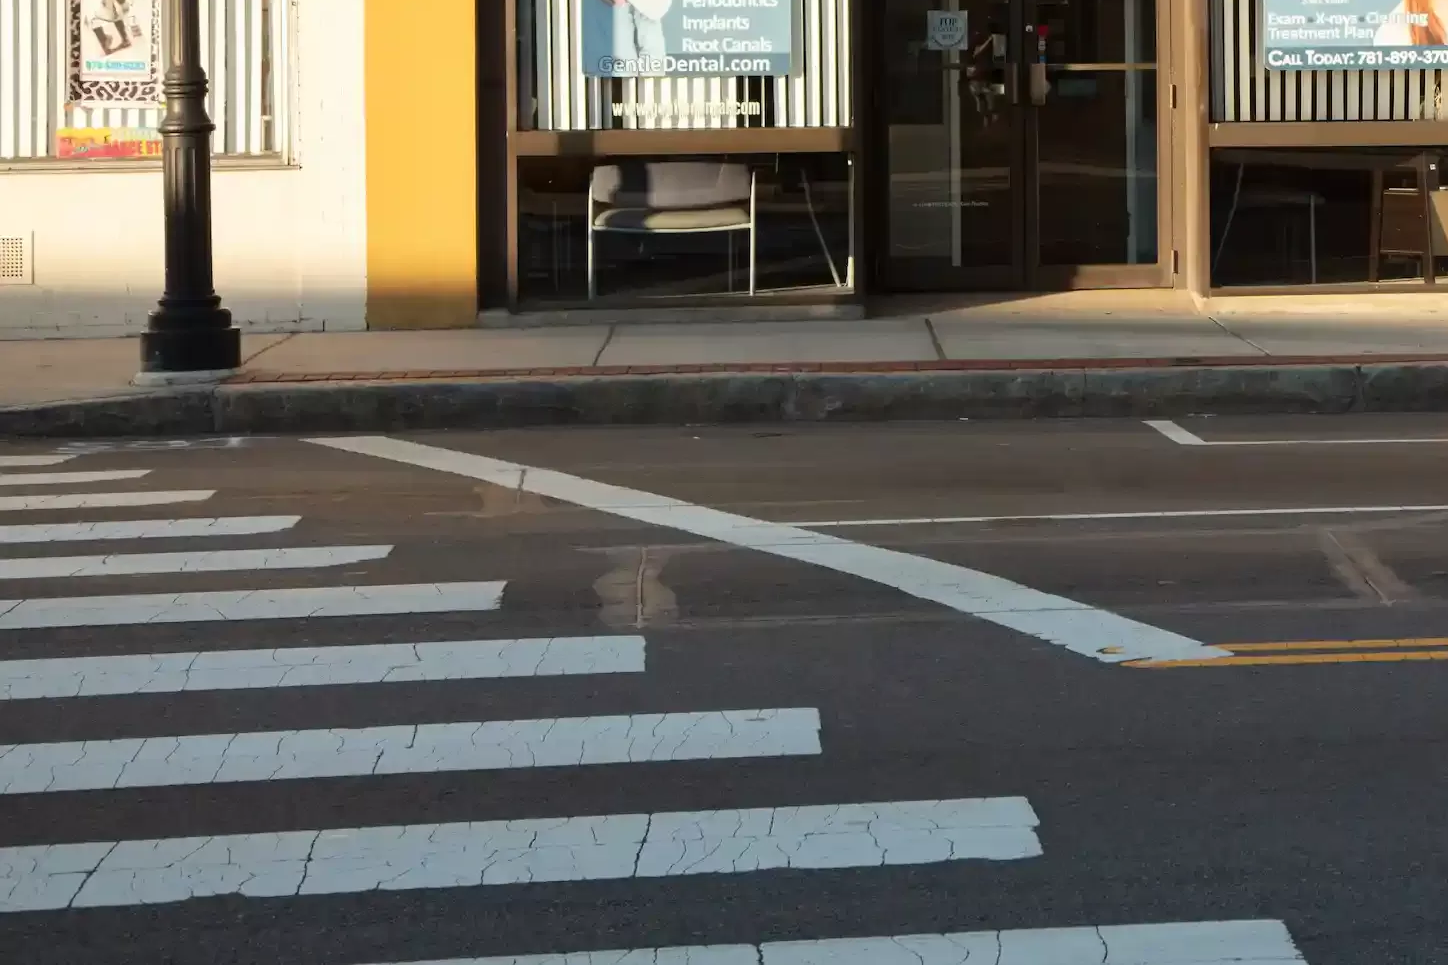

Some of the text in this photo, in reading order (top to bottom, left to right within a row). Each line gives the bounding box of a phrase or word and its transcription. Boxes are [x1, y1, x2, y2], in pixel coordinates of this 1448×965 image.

[682, 14, 749, 33] Implants
[1267, 13, 1306, 25] Exam
[1315, 12, 1358, 27] X-rays
[1267, 26, 1375, 40] Treatment Plan
[682, 36, 773, 53] Root Canals
[598, 55, 771, 72] GentleDental.com
[1268, 50, 1303, 66] CALL
